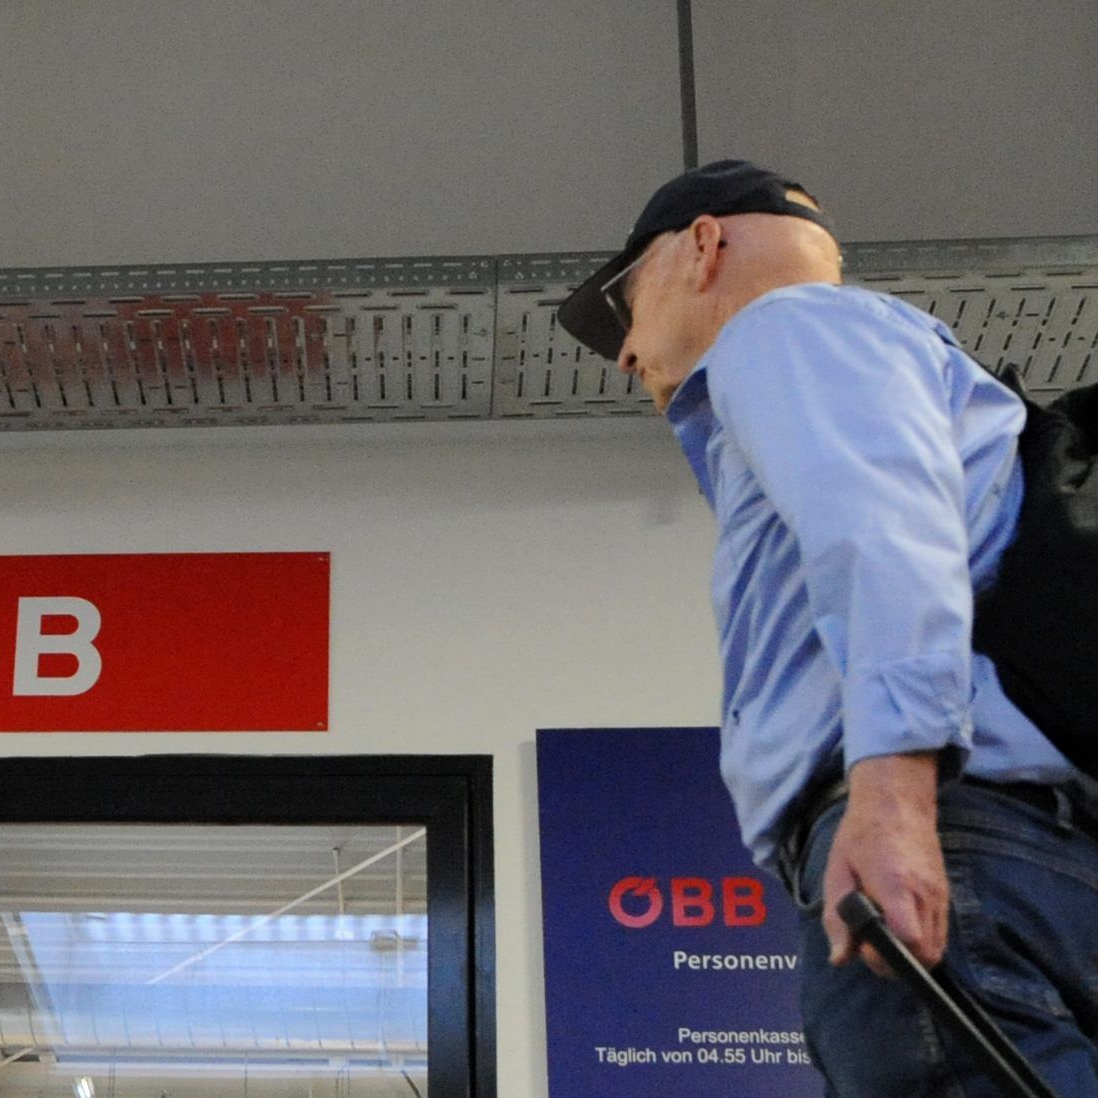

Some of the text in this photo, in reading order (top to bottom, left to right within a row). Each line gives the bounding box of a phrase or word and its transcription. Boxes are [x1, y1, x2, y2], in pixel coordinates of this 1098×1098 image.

[673, 950, 800, 970] Personenv
[594, 1046, 812, 1067] Täglich von 04.55 Uhr bis
